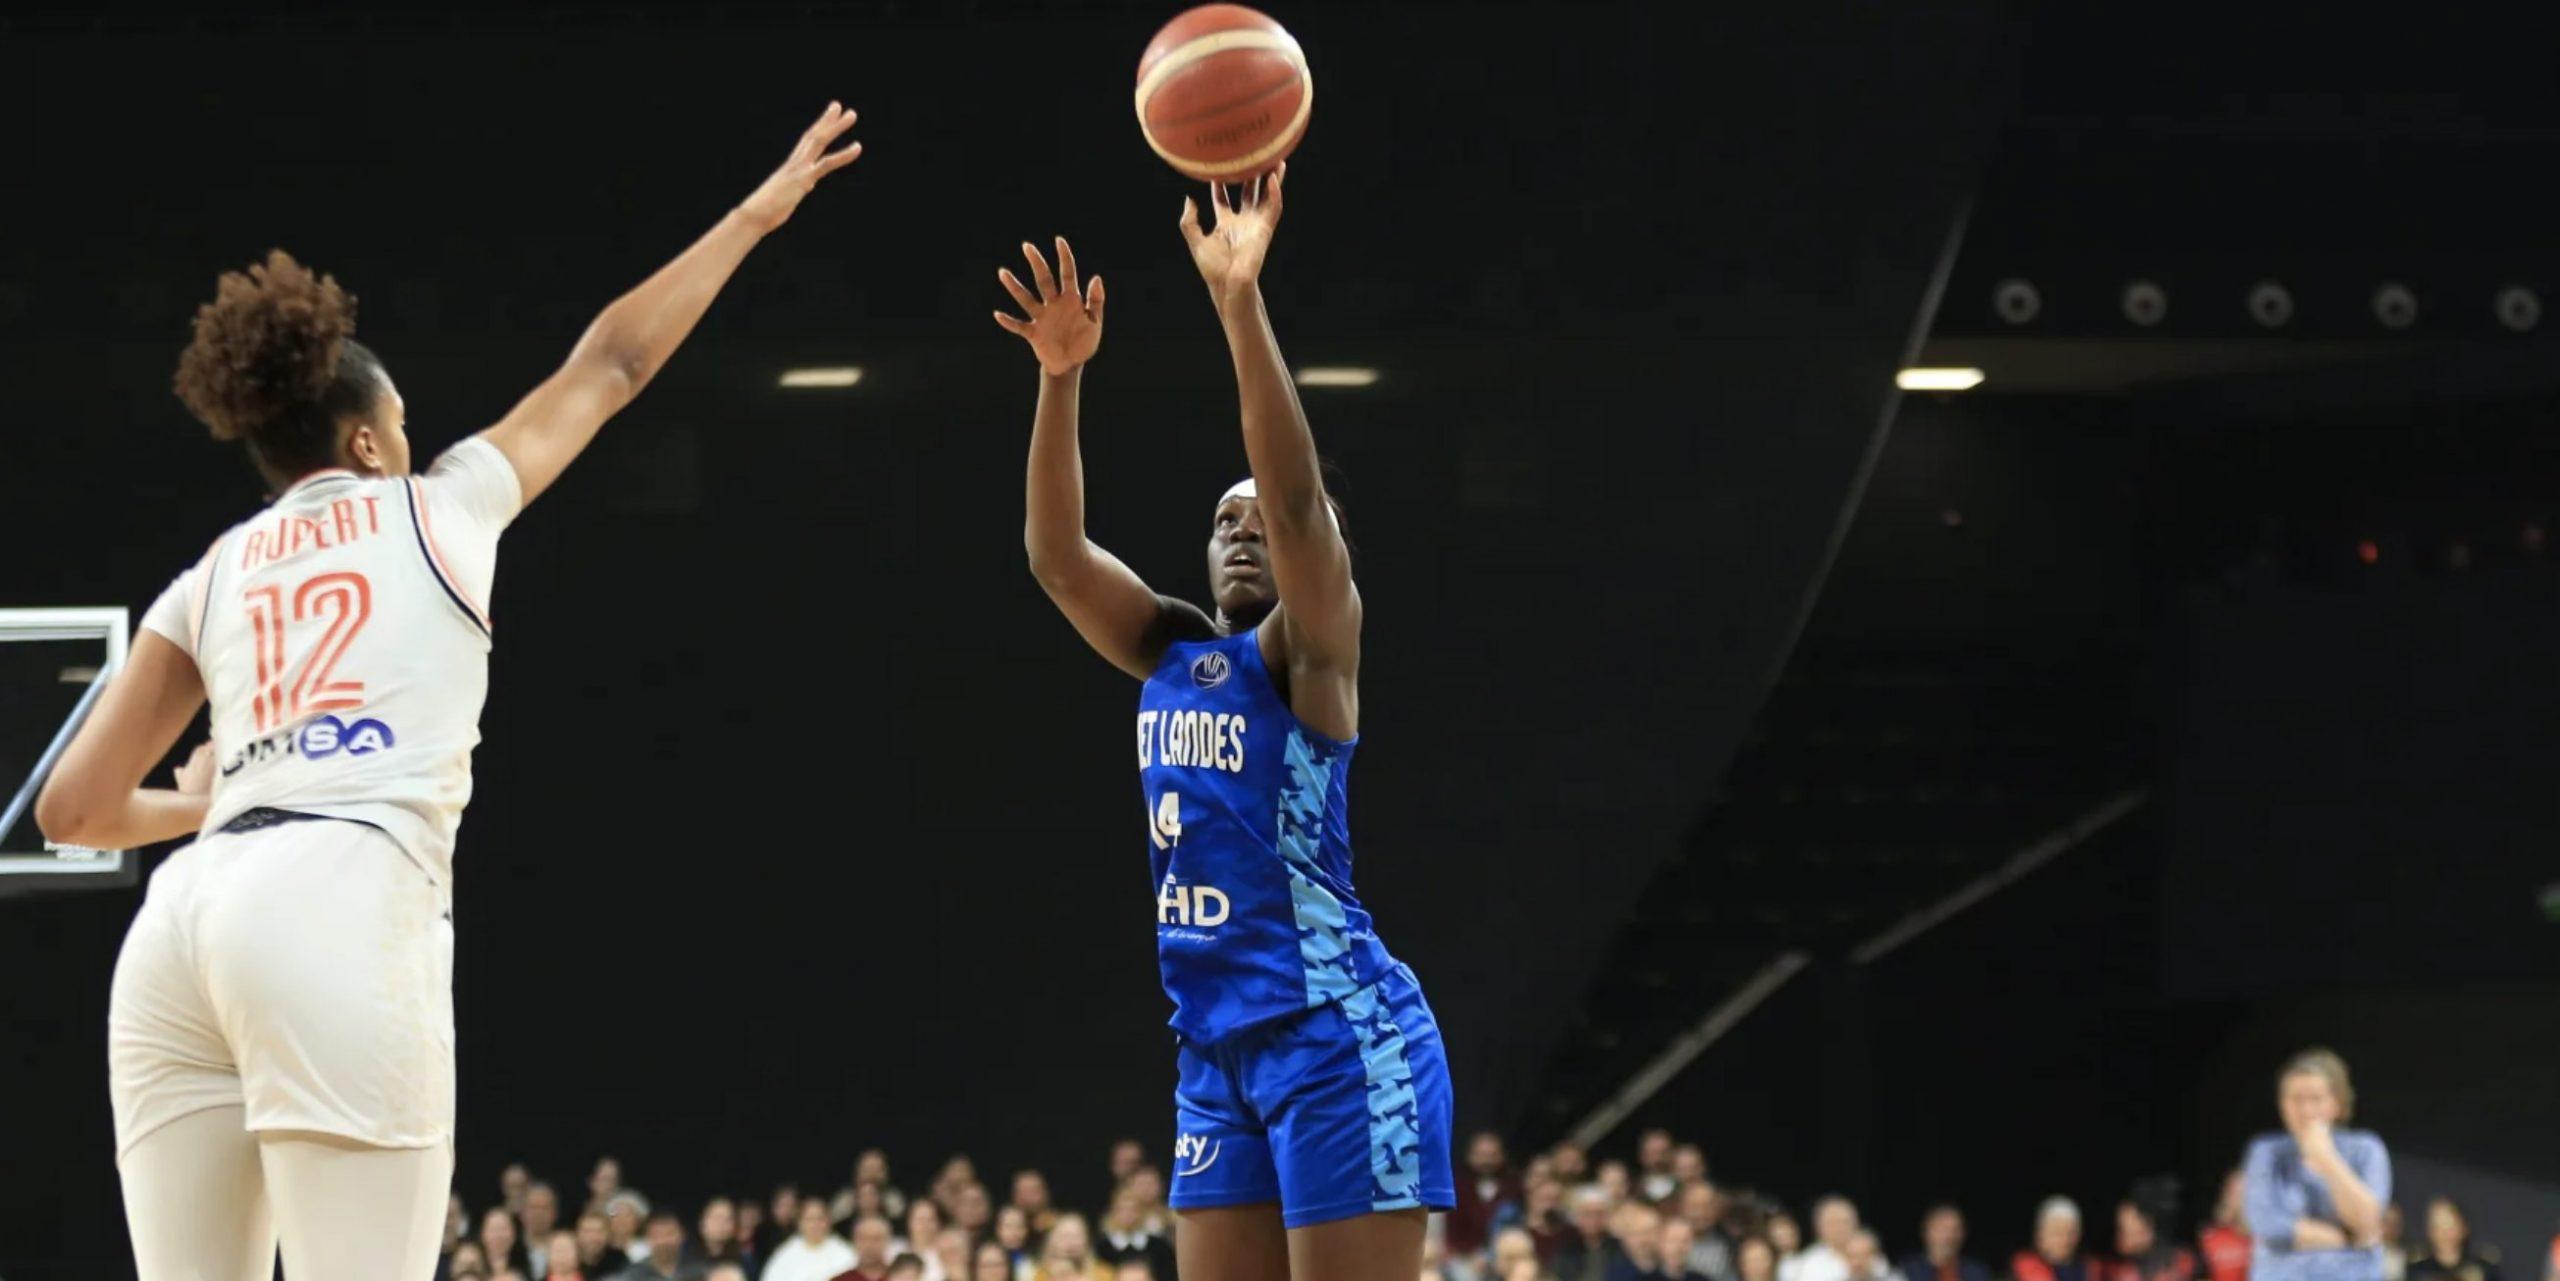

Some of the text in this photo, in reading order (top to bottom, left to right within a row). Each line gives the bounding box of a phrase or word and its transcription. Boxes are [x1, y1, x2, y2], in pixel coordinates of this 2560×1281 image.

[242, 497, 380, 571] RUPERT
[245, 571, 371, 733] 12
[1160, 710, 1246, 773] LANDES
